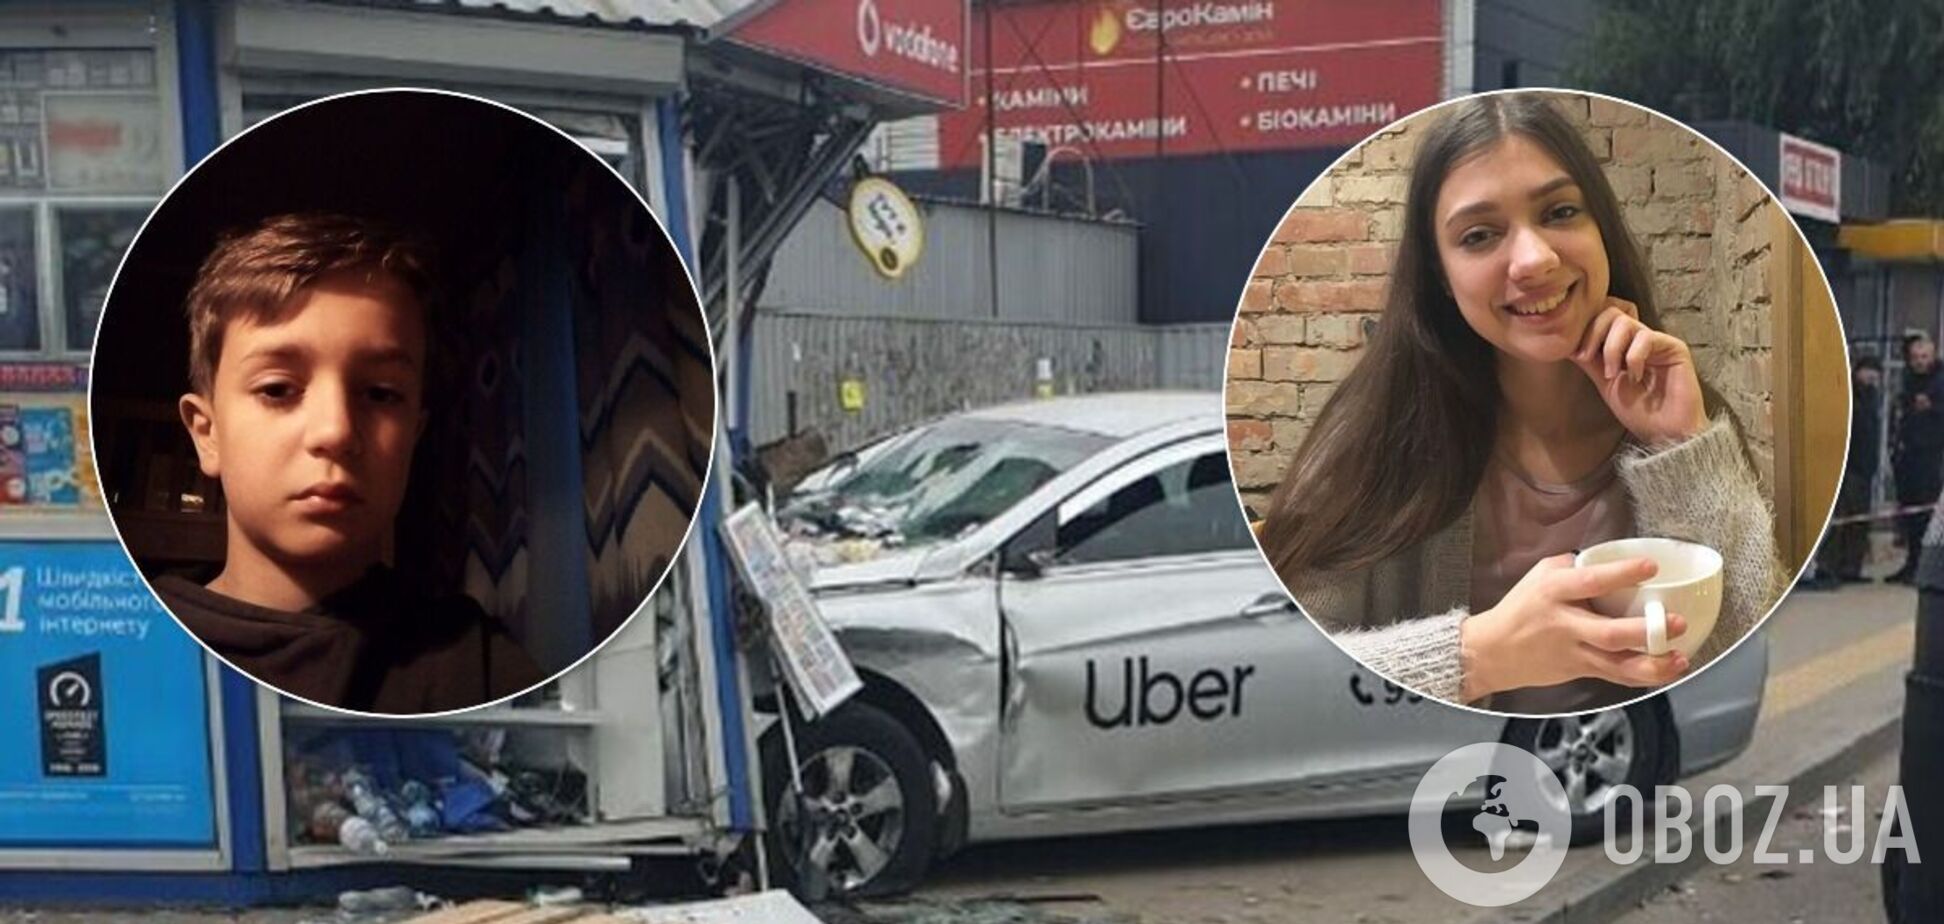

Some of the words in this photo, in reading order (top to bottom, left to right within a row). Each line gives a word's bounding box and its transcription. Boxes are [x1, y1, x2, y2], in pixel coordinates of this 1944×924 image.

[882, 20, 958, 73] vodafone
[1257, 69, 1318, 92] ПЕЧІ
[993, 84, 1088, 111] КАМІНИ
[1257, 102, 1396, 132] БІОКАМІНИ
[1084, 656, 1255, 730] Uber
